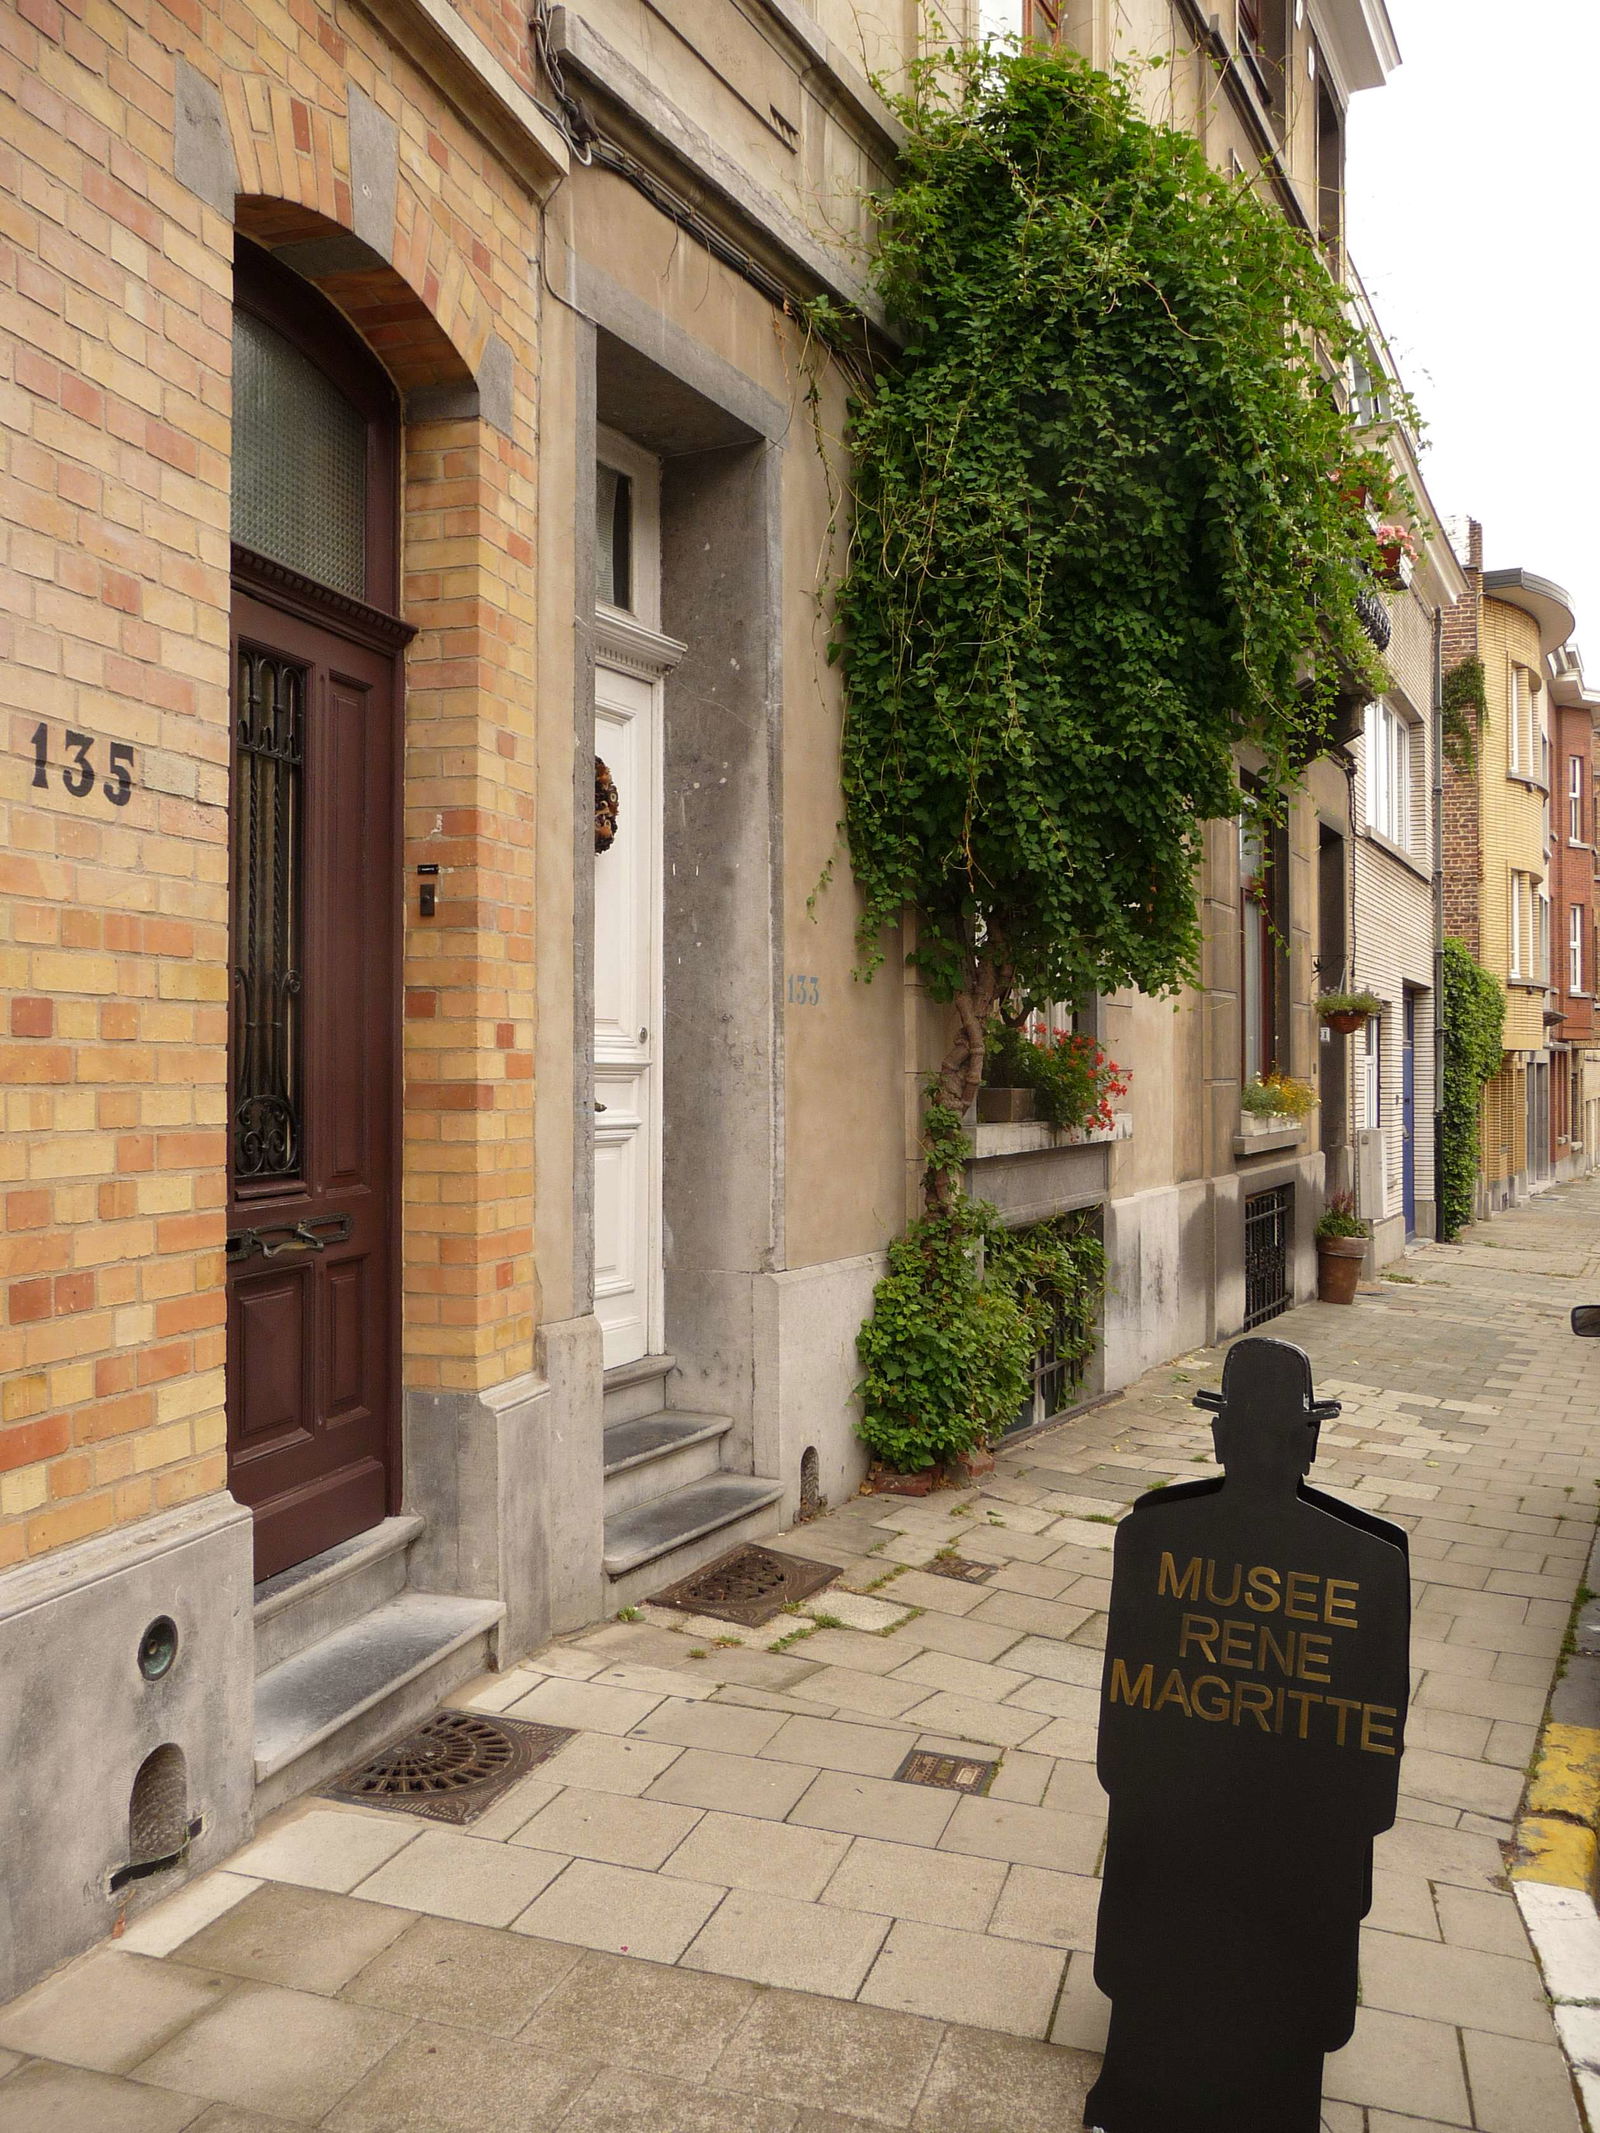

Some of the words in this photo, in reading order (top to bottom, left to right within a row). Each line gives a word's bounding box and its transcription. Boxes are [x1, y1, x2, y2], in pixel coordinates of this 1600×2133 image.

[31, 722, 134, 806] 135
[787, 975, 819, 1006] 133
[1157, 1551, 1360, 1629] MUSEE
[1179, 1613, 1333, 1683] RENE
[1109, 1658, 1398, 1755] MAGRITTE
